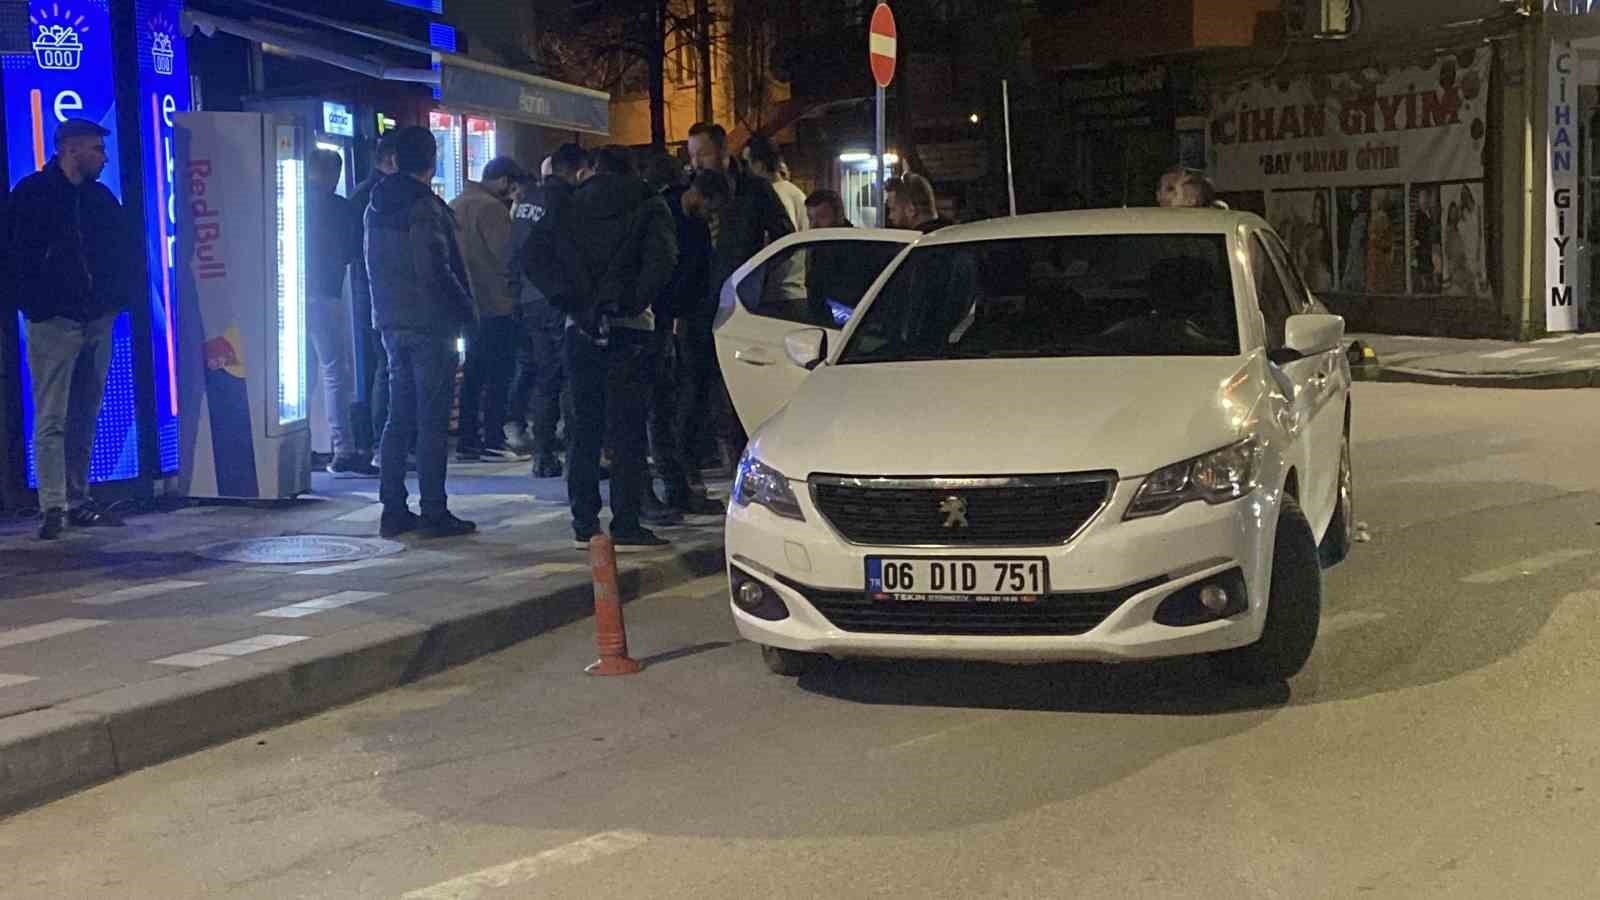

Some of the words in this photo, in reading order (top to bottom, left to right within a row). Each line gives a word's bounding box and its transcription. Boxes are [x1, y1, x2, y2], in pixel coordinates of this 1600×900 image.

[1211, 103, 1327, 144] CİHAN
[1341, 82, 1462, 135] GİYİM
[1553, 53, 1571, 172] CİHAN
[1551, 187, 1573, 307] GİYİM
[869, 577, 882, 587] TR
[883, 562, 915, 591] 06
[929, 562, 977, 592] DID
[993, 562, 1039, 592] 751
